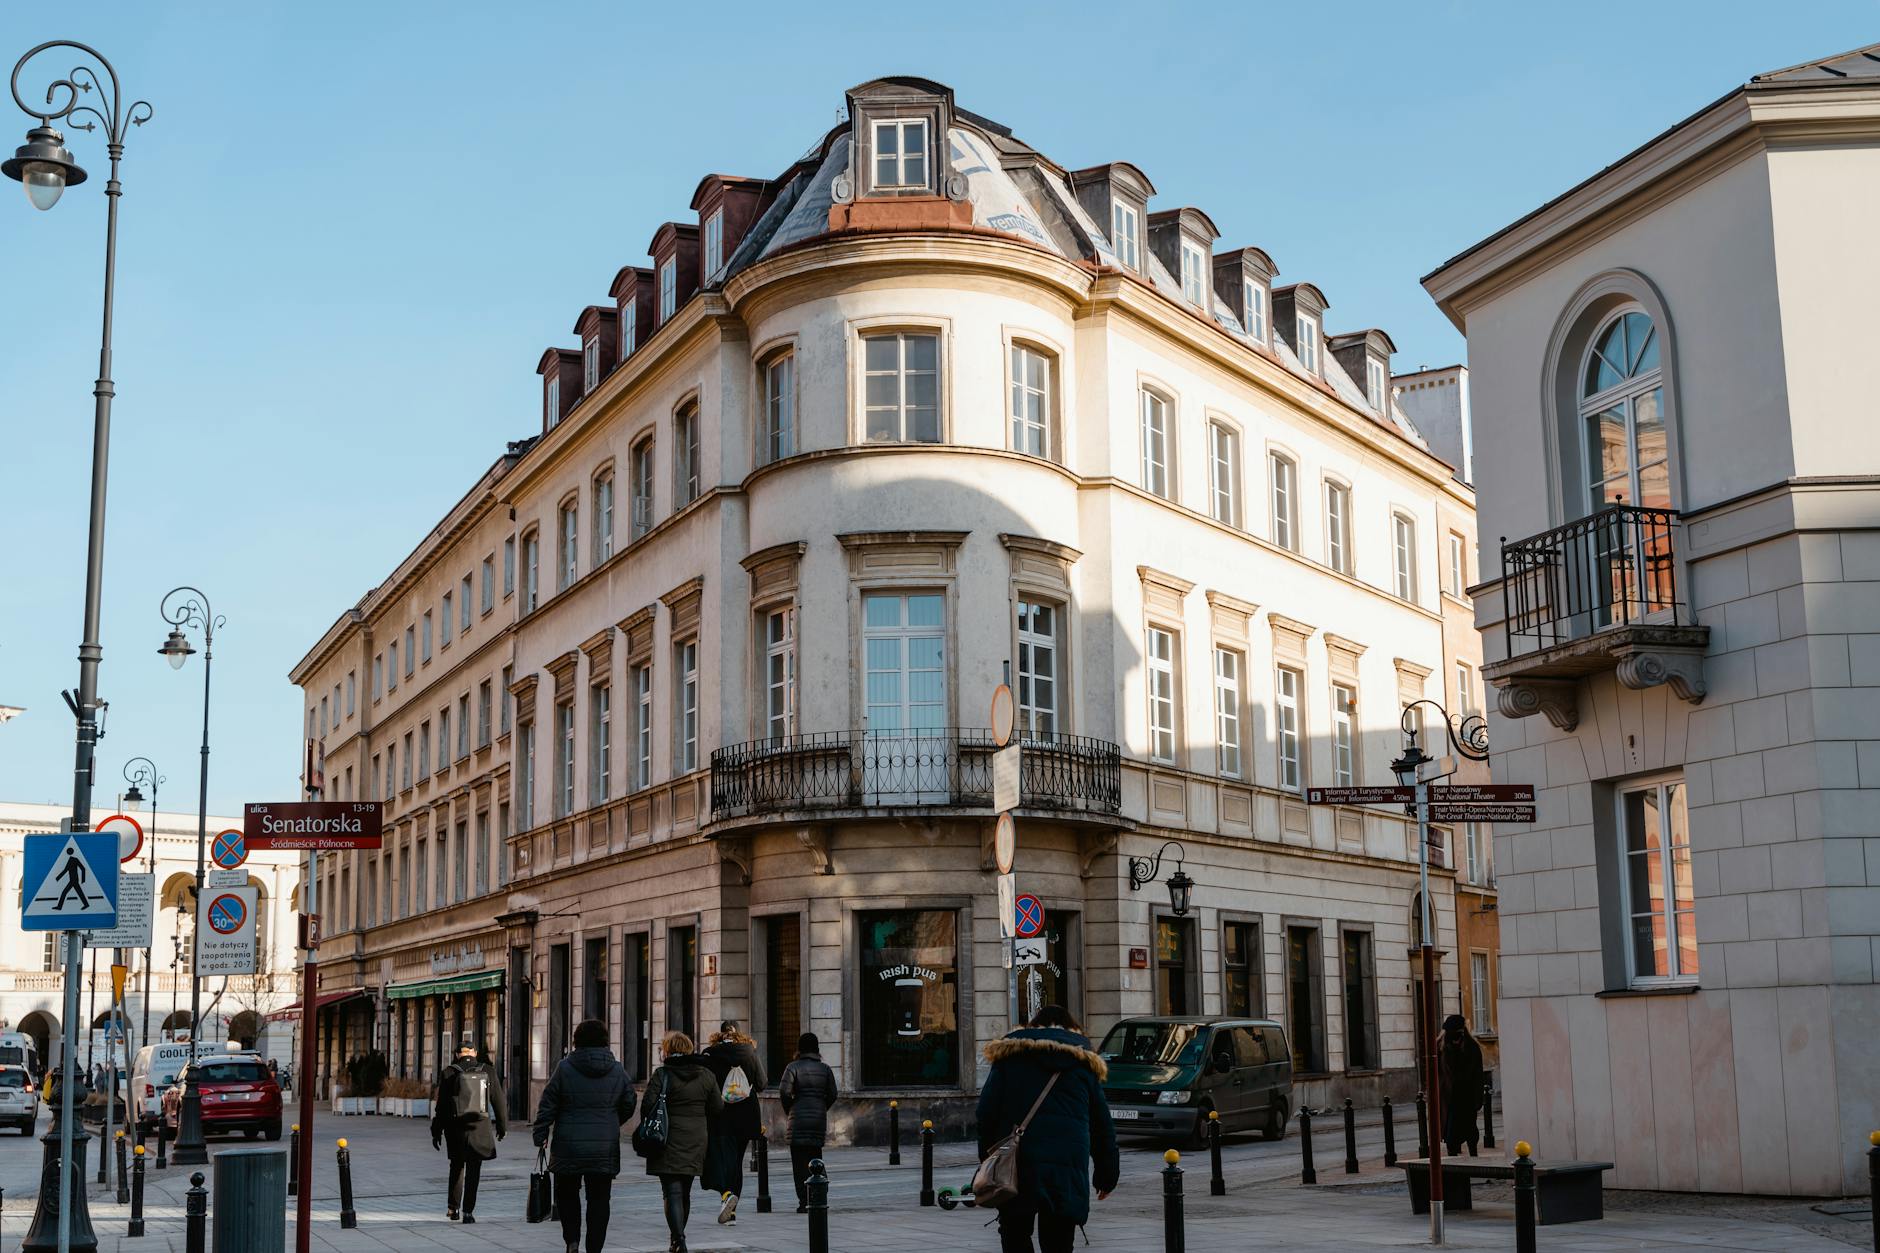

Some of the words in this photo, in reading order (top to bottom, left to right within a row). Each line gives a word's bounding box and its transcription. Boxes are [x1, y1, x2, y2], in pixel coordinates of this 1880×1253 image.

[1325, 789, 1357, 797] Informacja
[1360, 788, 1395, 797] Turystyczna
[1450, 787, 1482, 795] Narodowy
[250, 805, 268, 814] ulica
[353, 803, 375, 812] 13-19
[262, 812, 362, 834] Senatorska
[1511, 813, 1531, 822] Opera
[271, 838, 317, 849] Śródmieście
[319, 839, 355, 849] Północne
[213, 917, 227, 929] 30
[204, 942, 218, 950] Nie
[220, 942, 249, 953] dotyczy
[201, 951, 251, 961] zaopatrzenia
[209, 962, 230, 971] godz.
[233, 960, 251, 969] 20-7
[160, 1047, 215, 1059] COOLFOST
